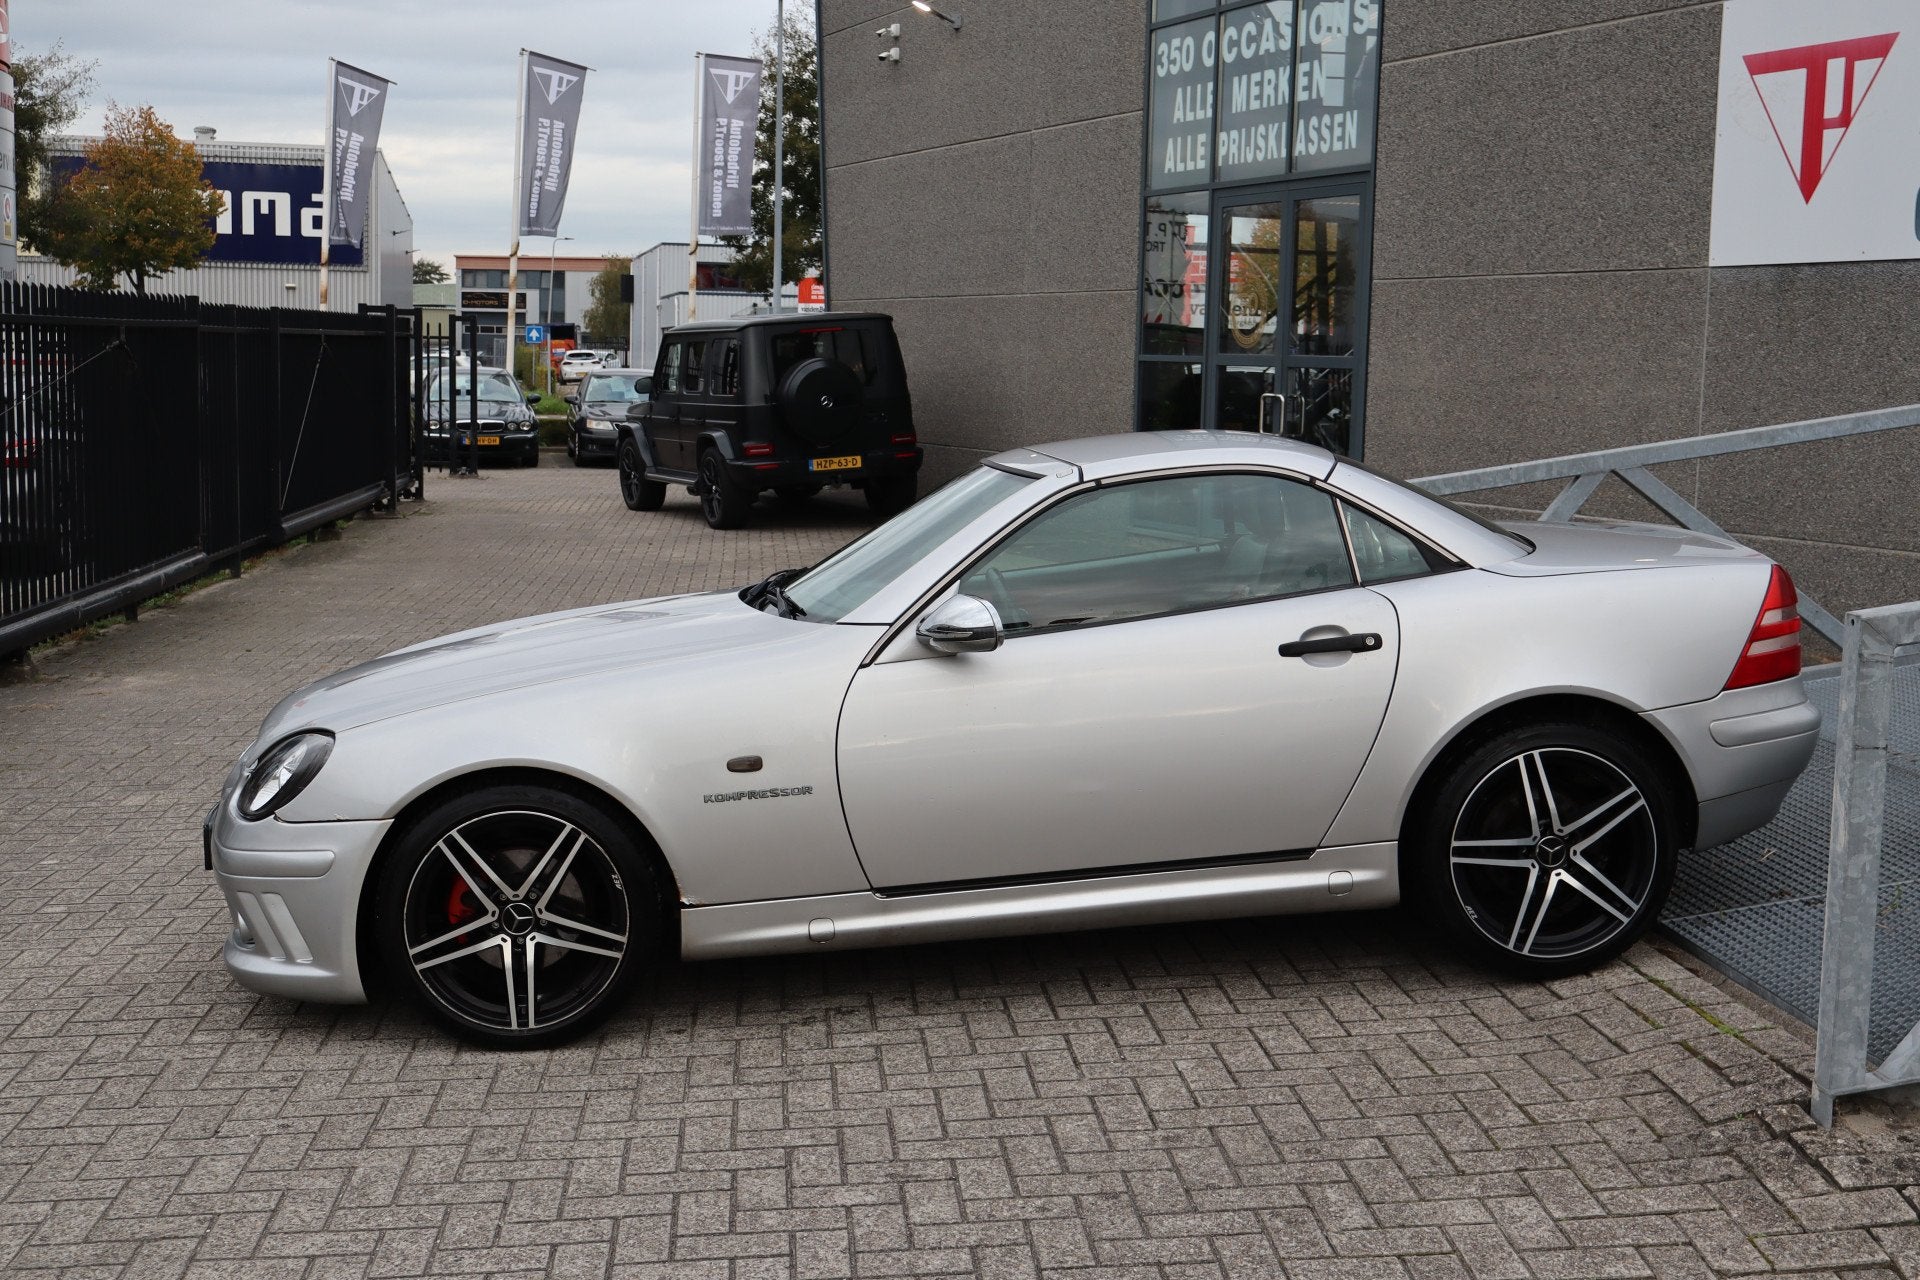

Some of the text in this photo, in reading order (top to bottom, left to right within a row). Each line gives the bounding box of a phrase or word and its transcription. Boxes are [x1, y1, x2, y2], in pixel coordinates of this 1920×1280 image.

[1156, 0, 1371, 78] 350 OCCASIONS
[1173, 60, 1327, 123] ALLE MERKEN
[340, 131, 364, 203] Autobedrijf
[544, 119, 565, 192] Autobedrijf
[726, 118, 744, 189] Autobedrijf
[1164, 110, 1358, 173] ALLE PRIJSKLASSEN
[712, 179, 723, 217] zonen
[816, 457, 858, 469] HZP-63-D
[703, 785, 814, 804] KOMPRESSOR
